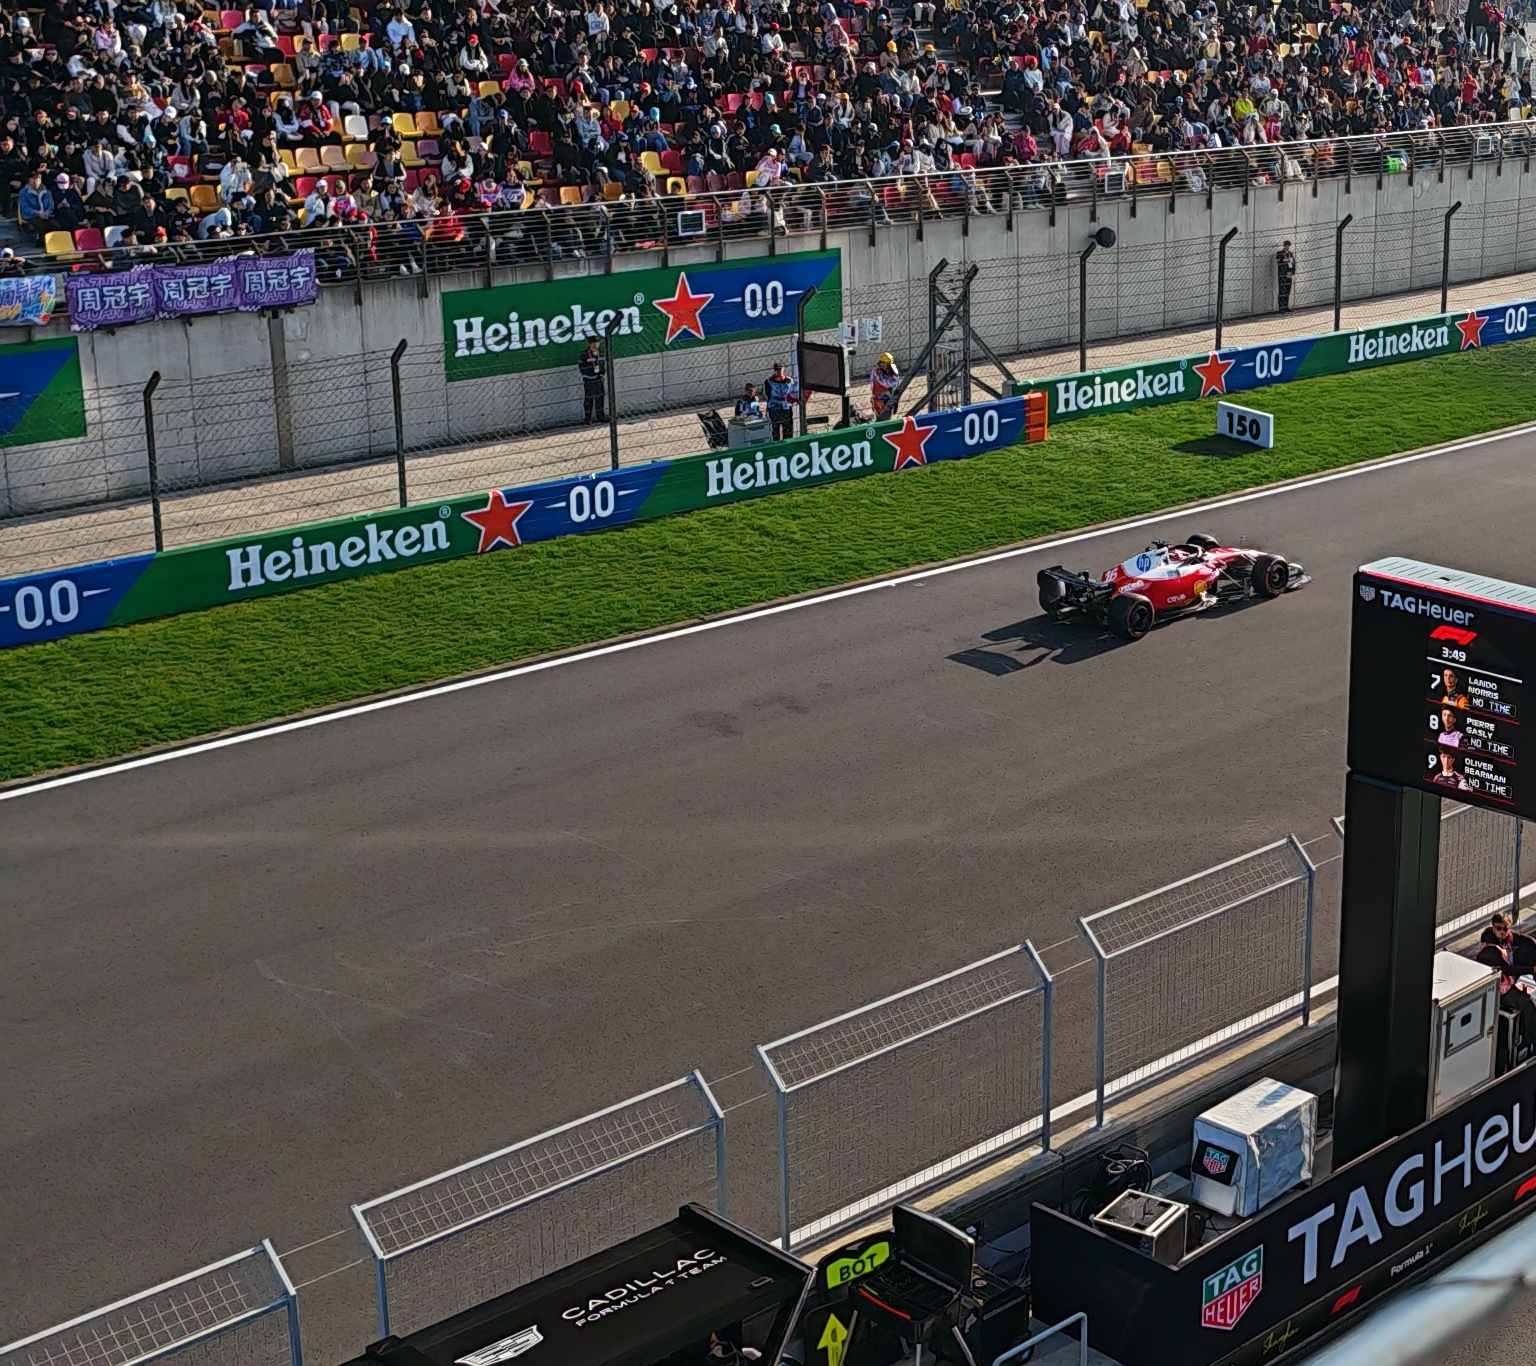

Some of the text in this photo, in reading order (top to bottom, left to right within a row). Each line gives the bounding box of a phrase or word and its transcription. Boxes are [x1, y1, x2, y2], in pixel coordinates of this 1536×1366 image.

[163, 272, 233, 303] 周冠宇
[244, 264, 312, 295] 周冠宇
[76, 281, 152, 314] 周冠宇
[453, 304, 644, 358] Heineken
[1347, 323, 1449, 364] Heineken
[1055, 368, 1186, 415] Heineken
[1226, 411, 1261, 441] 150
[705, 440, 874, 497] Heineken
[225, 521, 451, 592] Heineken
[1441, 646, 1466, 662] 3:49
[1430, 673, 1441, 689] 7
[1468, 676, 1498, 691] LANDO
[1468, 686, 1499, 701] NORRIS
[1472, 697, 1511, 716] NO TIME
[1429, 714, 1439, 730] 8
[1466, 717, 1496, 732] PIERRE
[1466, 726, 1493, 741] GASLY
[1470, 737, 1509, 756] NO TIME
[1427, 754, 1437, 769] 9
[1464, 757, 1494, 772] OLIVER
[1464, 766, 1507, 784] BEARMAN
[1468, 777, 1507, 796] NO TIME
[1208, 1149, 1228, 1163] TAG
[838, 1252, 878, 1283] BOT
[1206, 1252, 1259, 1298] TAG
[1390, 1249, 1424, 1277] Formula
[561, 1248, 716, 1321] CADILLAC
[575, 1284, 664, 1327] FORMULA
[676, 1255, 728, 1281] TEAM
[1204, 1277, 1261, 1329] HEUER
